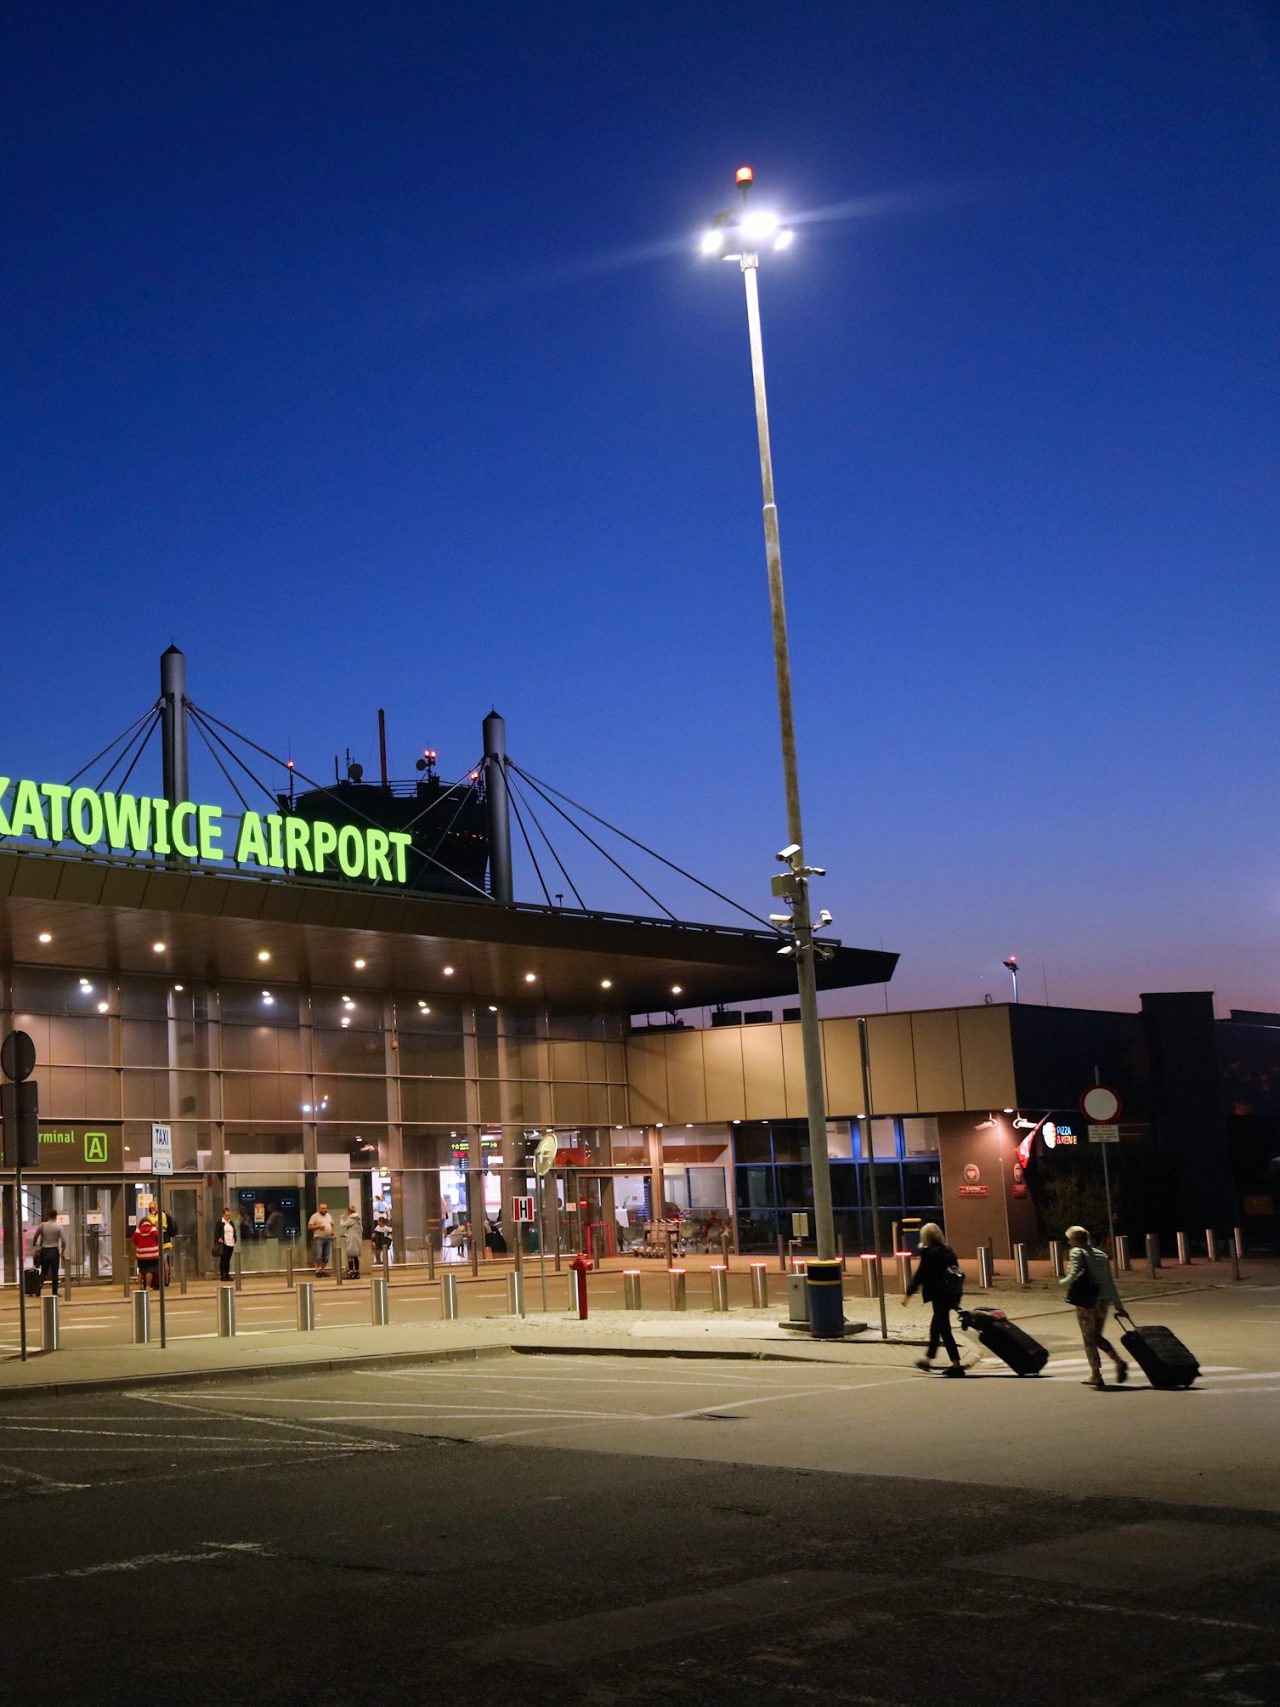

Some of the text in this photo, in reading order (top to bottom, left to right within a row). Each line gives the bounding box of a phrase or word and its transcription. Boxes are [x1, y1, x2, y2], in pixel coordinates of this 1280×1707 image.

[237, 812, 412, 883] AIRPORT
[38, 1130, 75, 1143] rminal
[155, 1129, 169, 1145] TAXI
[1056, 1126, 1072, 1135] PIZZA
[519, 1200, 528, 1218] H
